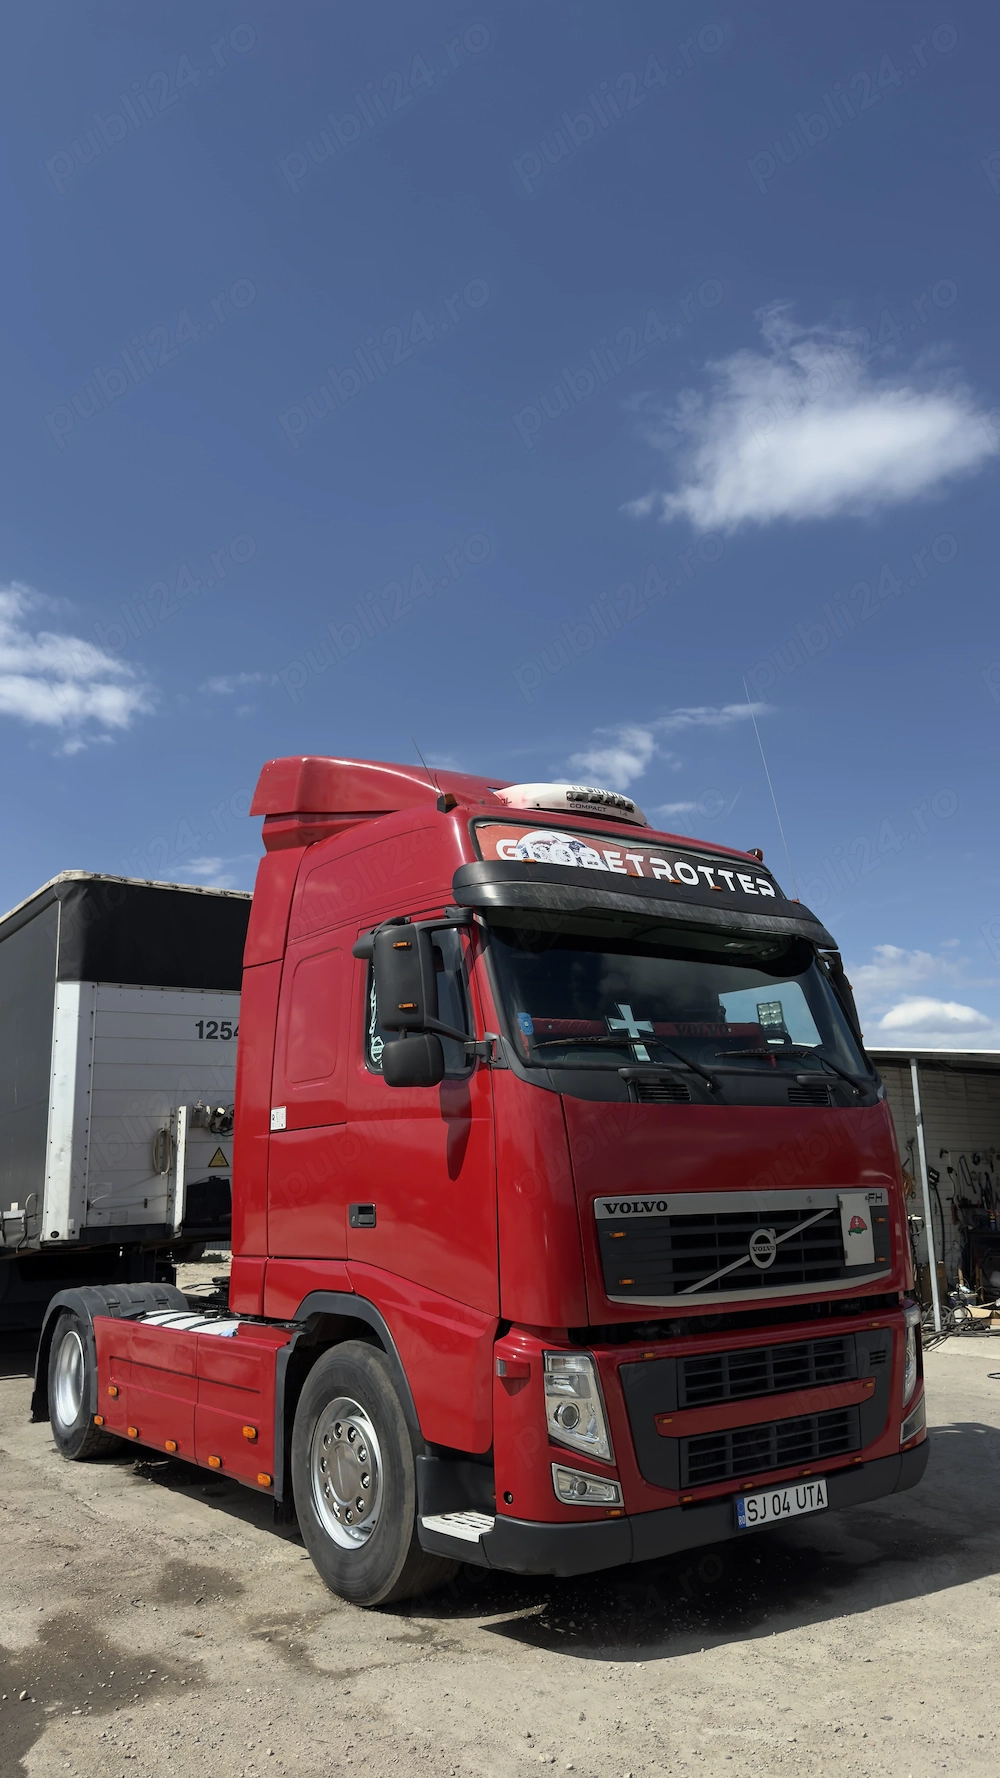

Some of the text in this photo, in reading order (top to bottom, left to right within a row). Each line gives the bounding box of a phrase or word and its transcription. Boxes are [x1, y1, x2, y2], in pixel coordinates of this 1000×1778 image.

[569, 802, 607, 812] COMPACT
[495, 839, 776, 898] GLOBETROTTER
[602, 1200, 668, 1215] VOLVO
[751, 1245, 776, 1253] VOLVO
[746, 1483, 825, 1523] SJ 04 UTA
